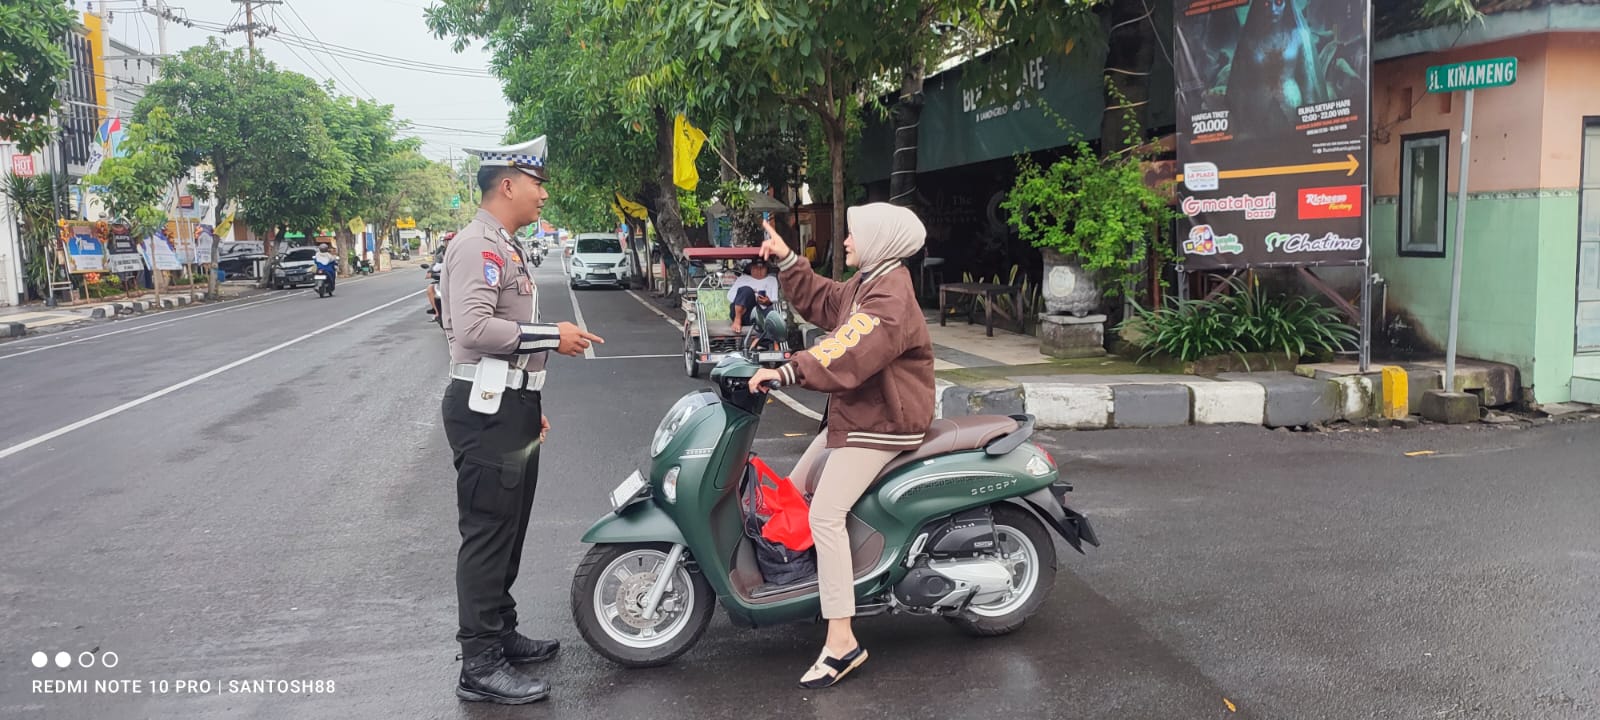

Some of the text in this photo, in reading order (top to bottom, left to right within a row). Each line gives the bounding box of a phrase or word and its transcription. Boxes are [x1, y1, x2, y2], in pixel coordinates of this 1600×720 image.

[1447, 62, 1514, 88] KINAMENG
[1192, 118, 1229, 134] 20.000
[14, 159, 31, 171] HOT
[1202, 192, 1275, 211] matahari
[1246, 209, 1275, 219] bazar
[1284, 232, 1362, 252] Chatime
[971, 479, 1018, 496] SCOOPY
